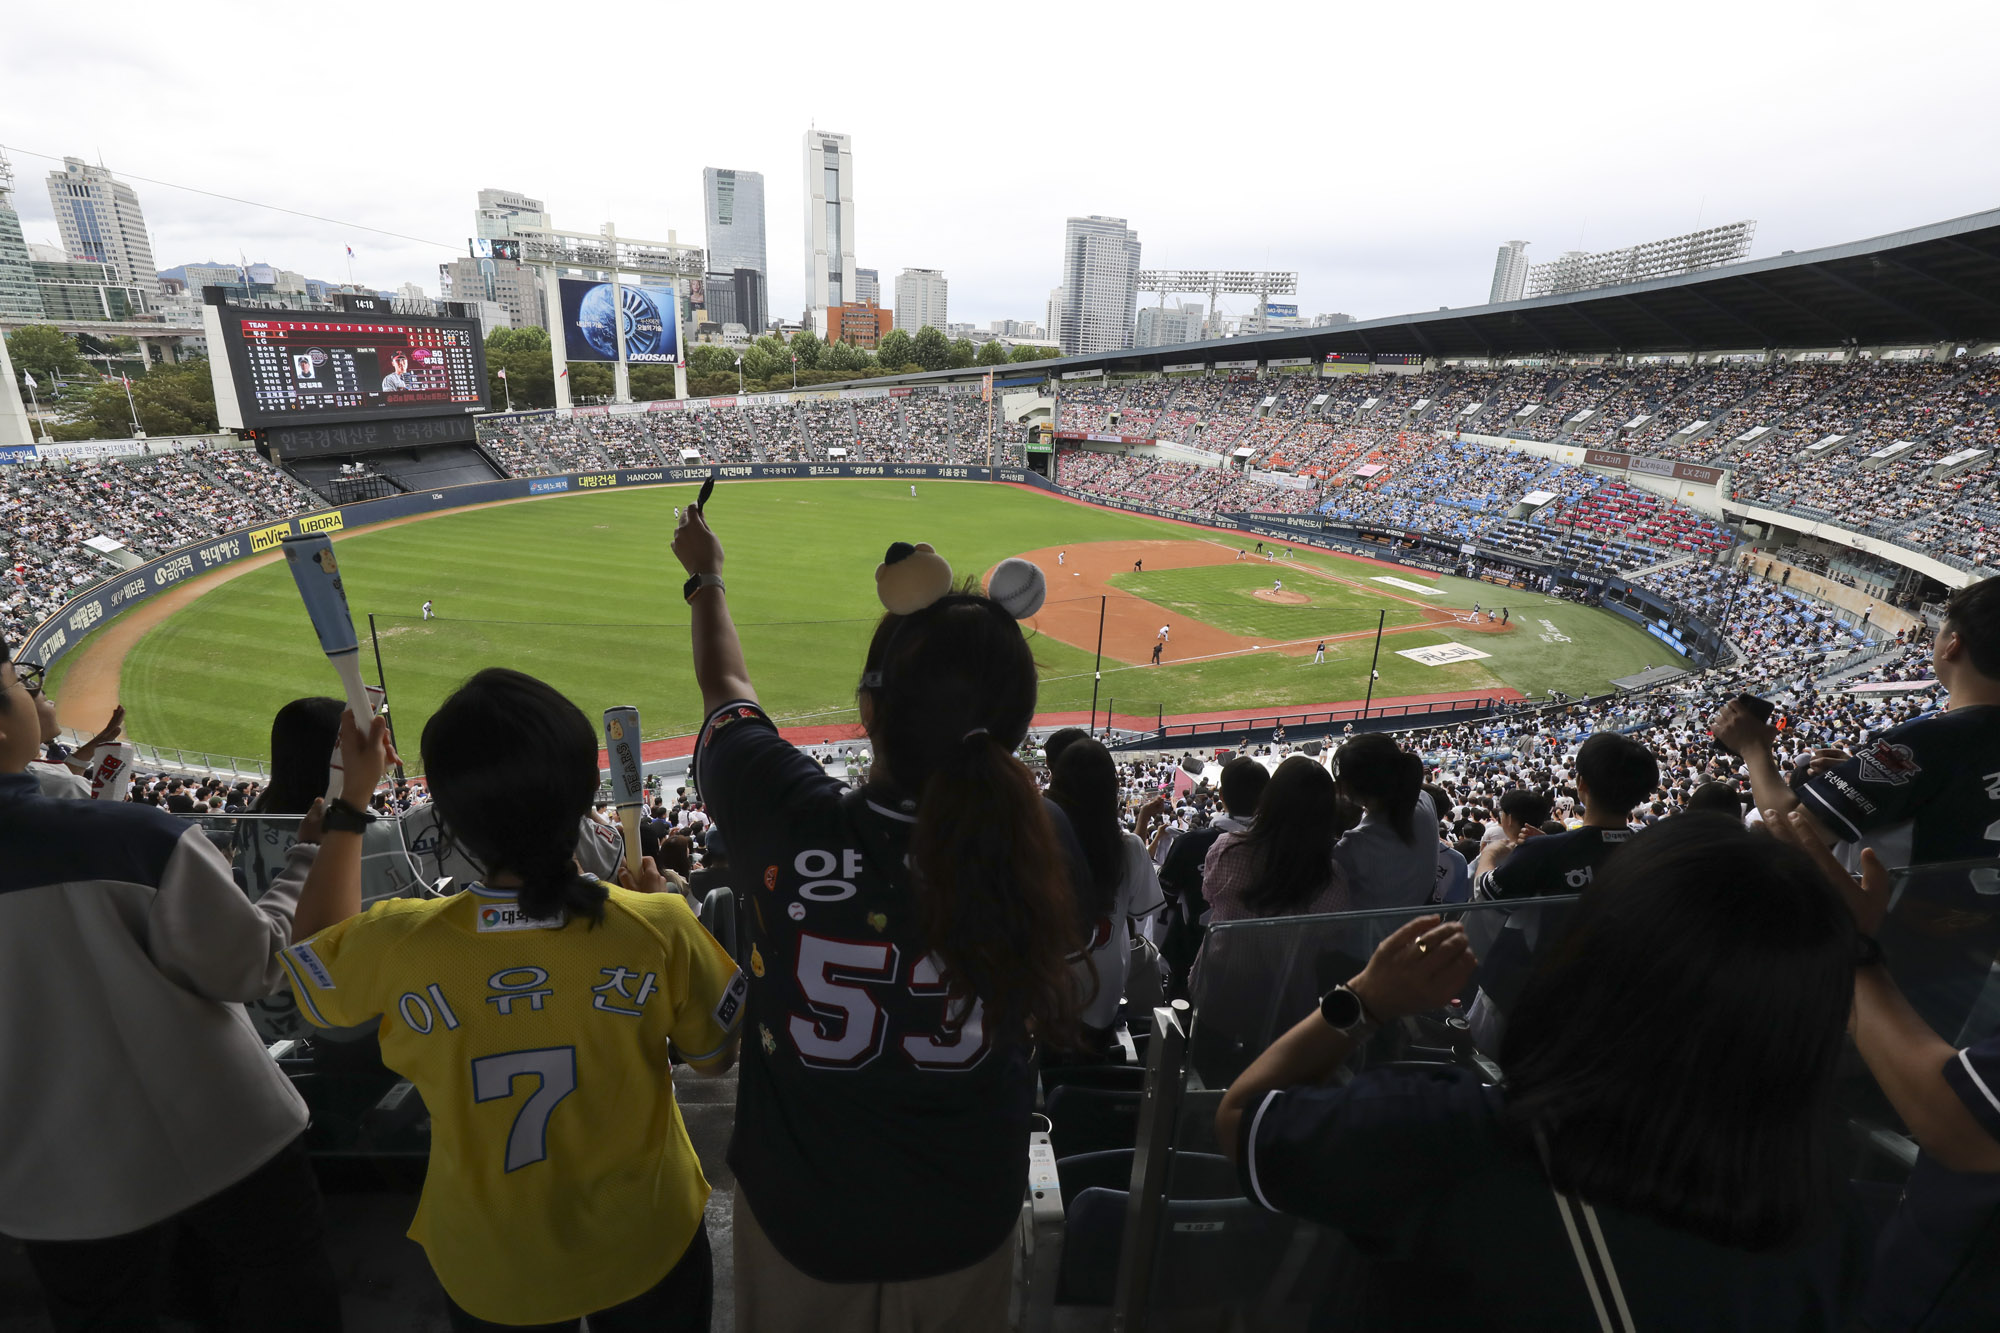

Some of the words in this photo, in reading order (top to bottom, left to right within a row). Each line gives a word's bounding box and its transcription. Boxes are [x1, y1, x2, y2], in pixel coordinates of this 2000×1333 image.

[355, 299, 374, 310] 14:18
[629, 353, 675, 362] DOOSAN
[280, 425, 378, 450] 한국경제신문
[392, 418, 467, 440] 한국경제TV
[1594, 453, 1604, 462] LX
[626, 472, 663, 482] HANCOM
[719, 466, 752, 477] 치킨마루
[762, 467, 797, 475] 한국경제TV
[938, 467, 968, 477] 키움증권
[1682, 468, 1693, 477] LX
[537, 480, 568, 491] 도미노피자
[578, 473, 617, 488] 대방건설
[301, 515, 342, 534] UBORA
[1286, 516, 1322, 530] 충남혁신도시
[200, 538, 240, 567] 현대해상
[166, 554, 194, 582] 금강주택
[124, 577, 147, 600] 비타란
[616, 742, 642, 793] BEARS
[1859, 750, 1902, 782] DOOSAN
[1823, 770, 1878, 815] 두산에너빌리티
[1562, 803, 1571, 811] 31
[399, 965, 660, 1035] 이유찬
[787, 929, 994, 1073] 53
[470, 1044, 578, 1174] 7
